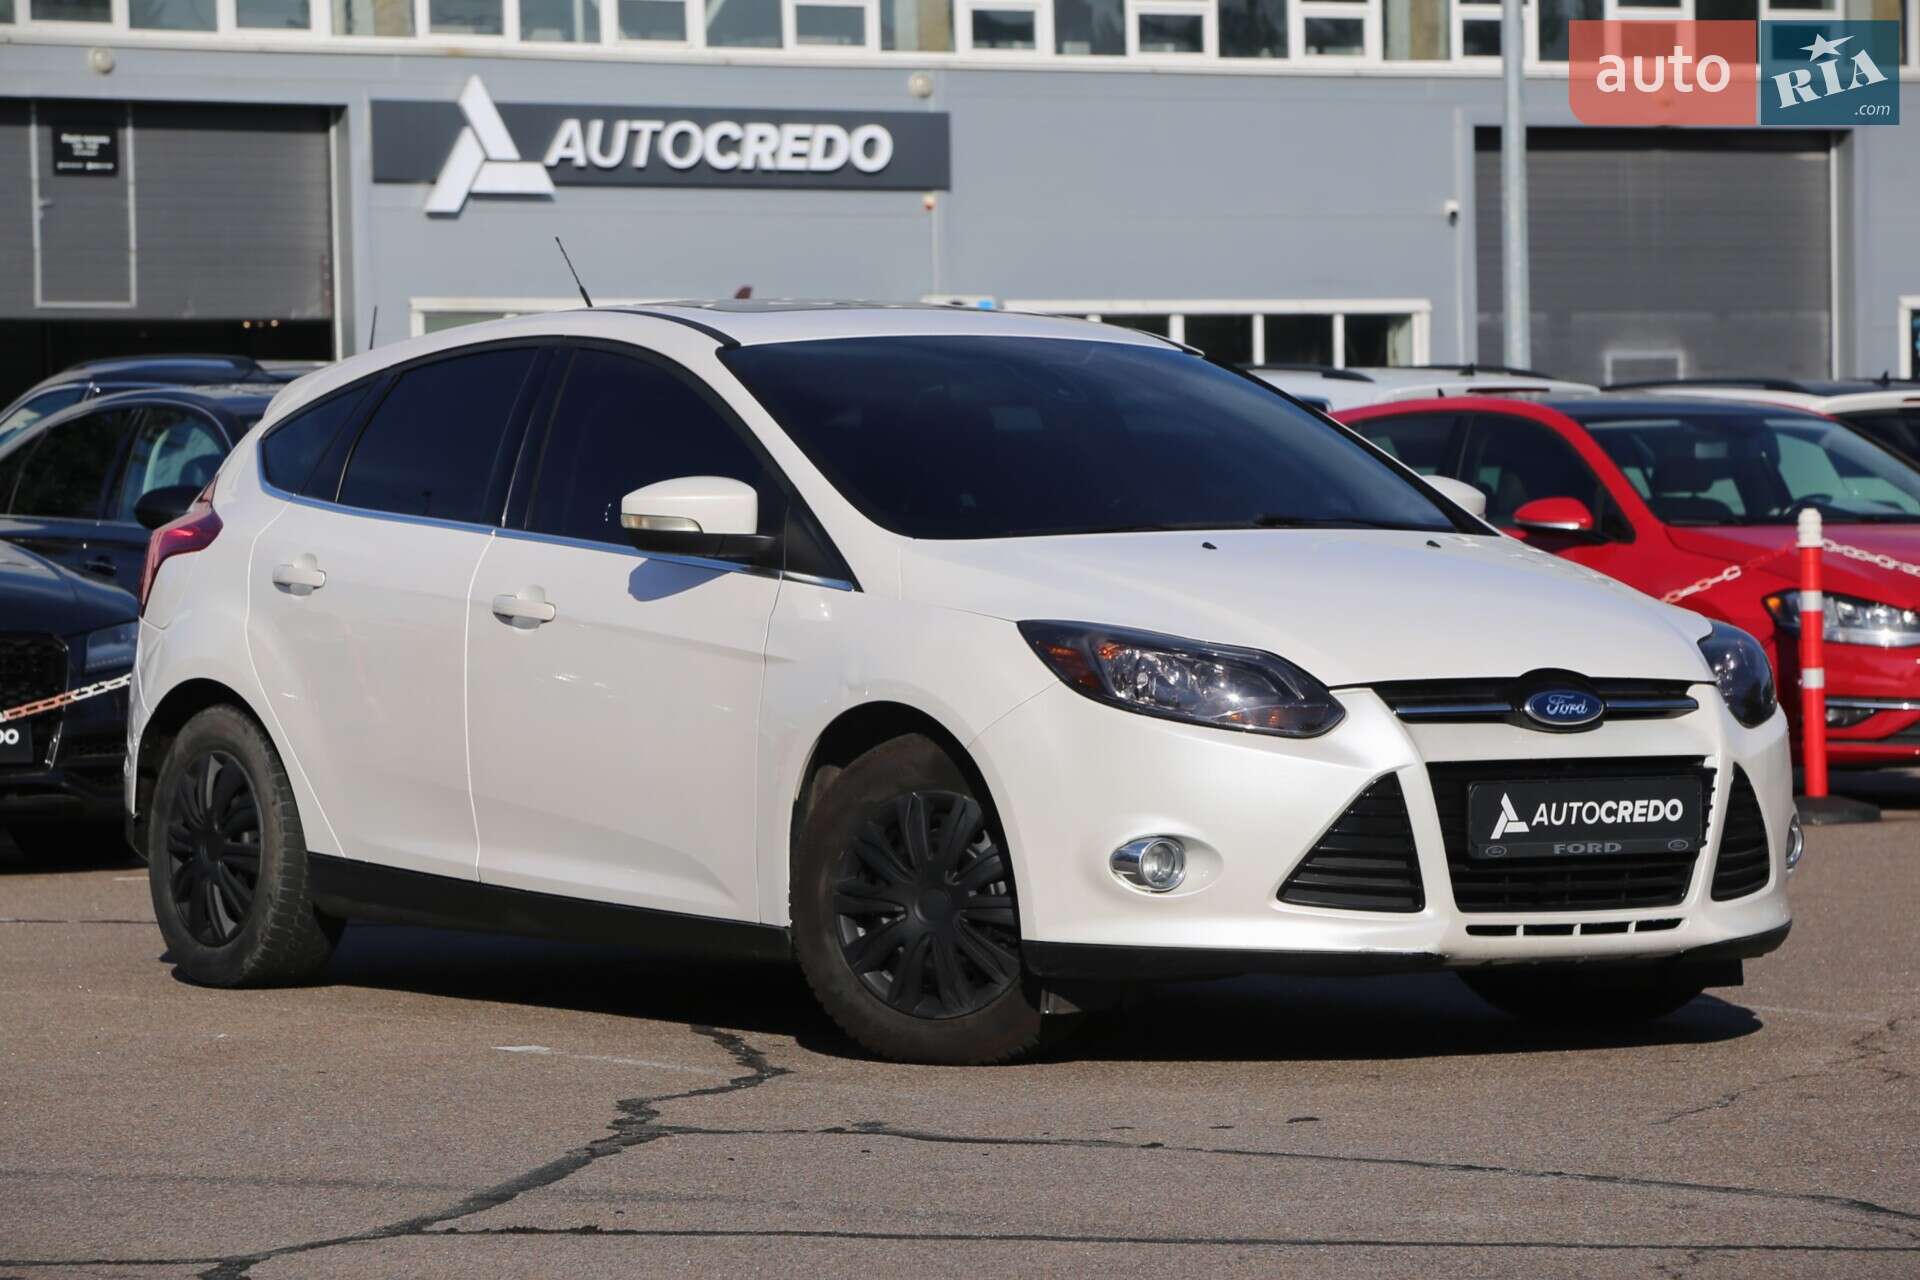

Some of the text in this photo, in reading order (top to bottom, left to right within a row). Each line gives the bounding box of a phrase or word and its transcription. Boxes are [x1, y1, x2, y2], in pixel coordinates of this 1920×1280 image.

[545, 118, 893, 173] AUTOCREDO
[1546, 694, 1588, 715] Ford
[1532, 798, 1684, 826] AUTOCREDO
[1553, 842, 1622, 854] FORD
